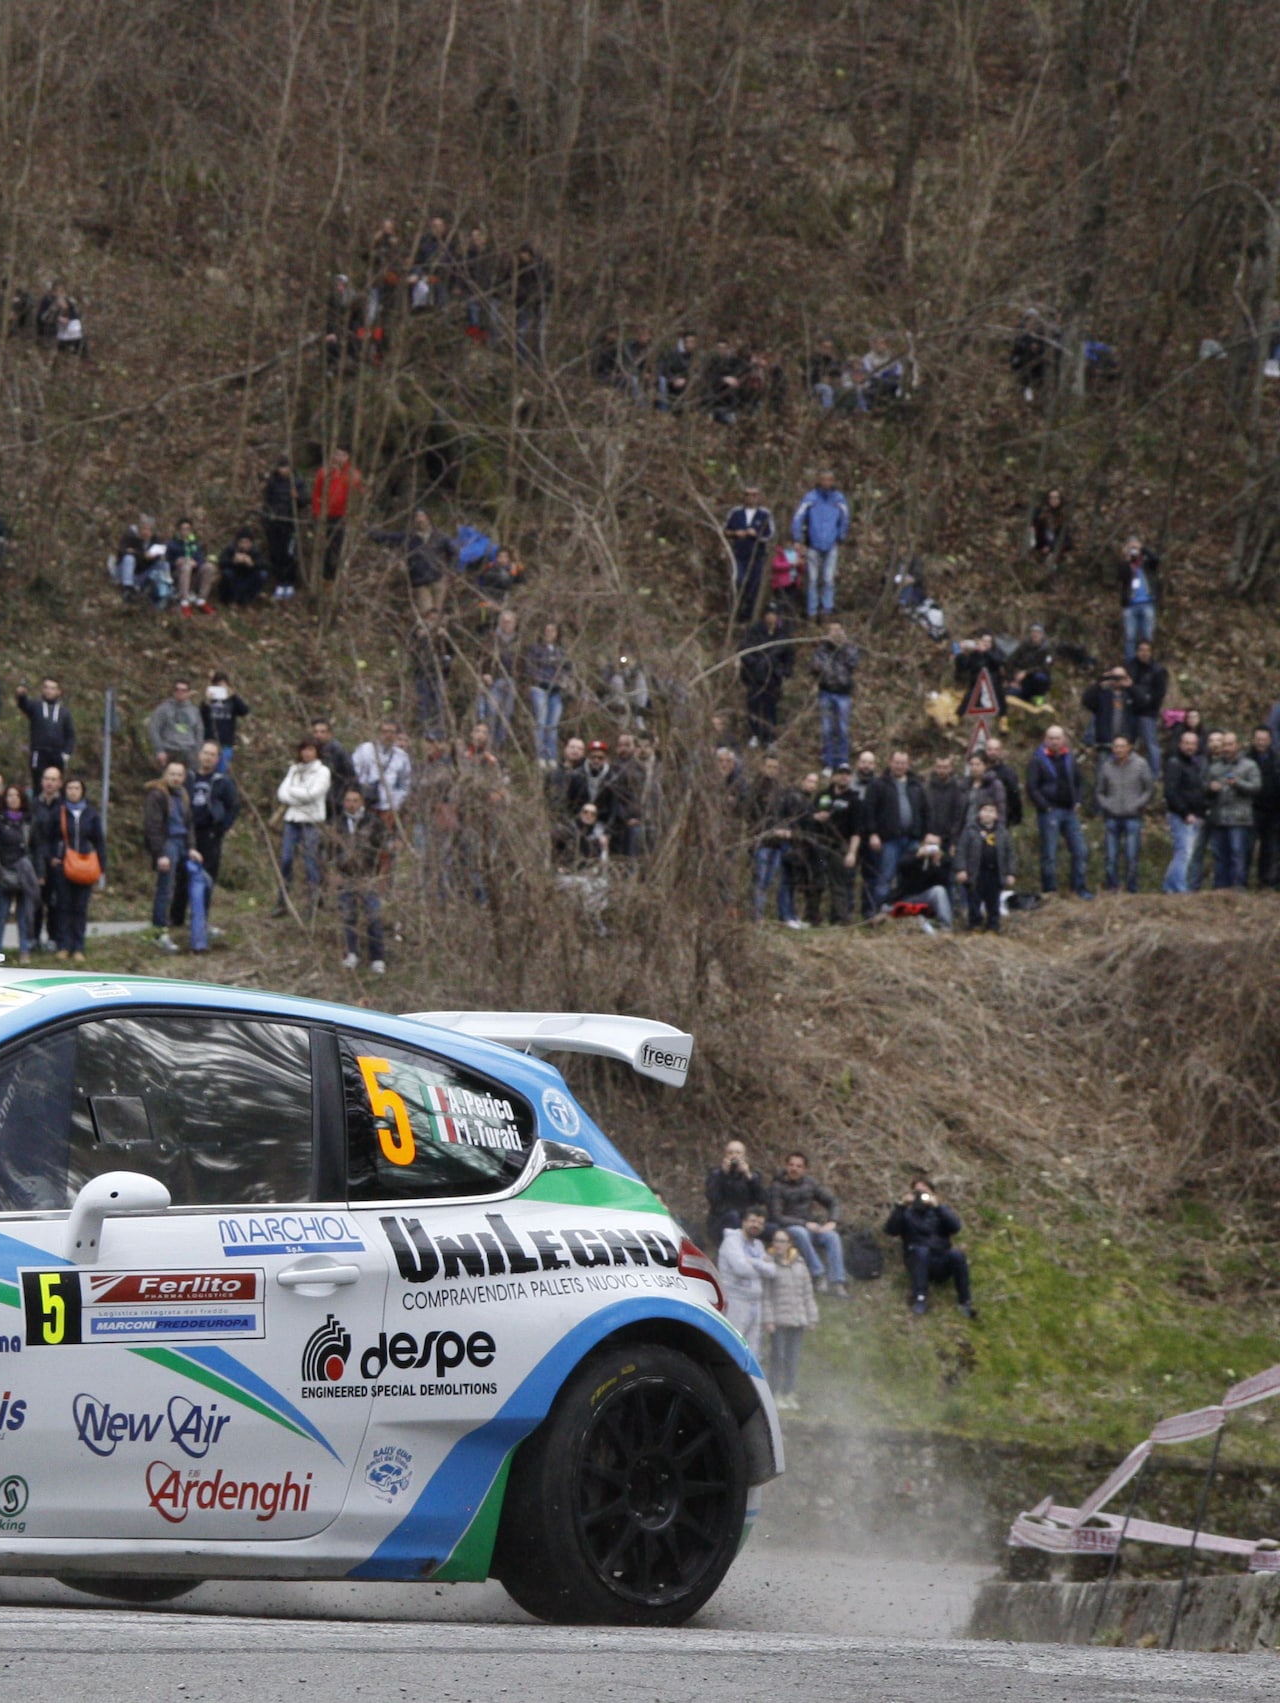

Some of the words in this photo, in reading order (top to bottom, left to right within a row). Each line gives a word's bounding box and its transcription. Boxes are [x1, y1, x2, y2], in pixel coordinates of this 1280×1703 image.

[643, 1044, 688, 1070] freem
[357, 1056, 416, 1166] 5
[446, 1088, 515, 1120] A.Perico
[451, 1117, 523, 1151] M.Turati
[218, 1216, 360, 1243] MARCHIOL
[138, 1277, 242, 1294] Ferlito
[402, 1282, 525, 1310] COMPRAVENDITA
[531, 1278, 584, 1297] PALLETS
[586, 1273, 639, 1291] NUOVO
[643, 1274, 652, 1288] E
[654, 1273, 689, 1291] USATO
[39, 1273, 65, 1344] 5
[98, 1309, 138, 1317] Logistica
[360, 1331, 497, 1379] despe
[302, 1386, 368, 1399] ENGINEERED
[371, 1384, 417, 1397] SPECIAL
[420, 1382, 498, 1396] DEMOLITIONS
[76, 1401, 164, 1443] New
[169, 1401, 231, 1444] Air
[149, 1469, 313, 1521] Ardenghi
